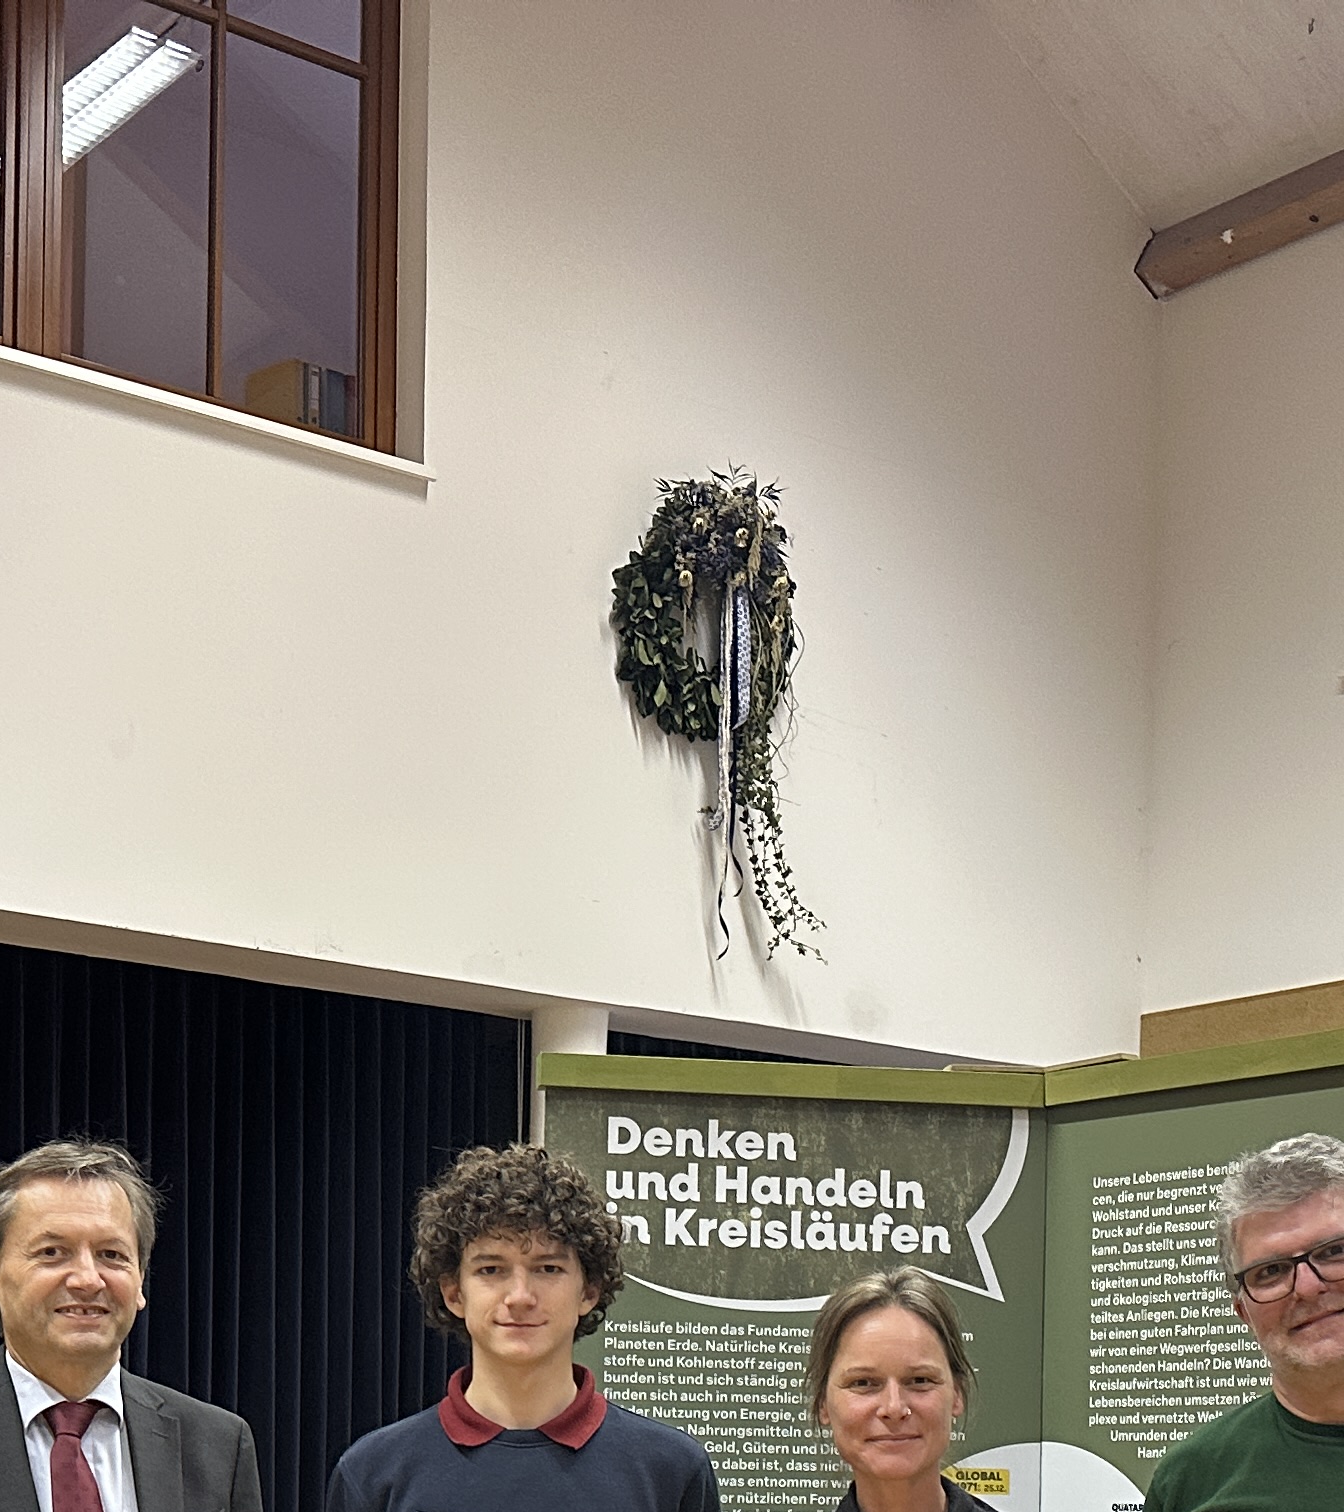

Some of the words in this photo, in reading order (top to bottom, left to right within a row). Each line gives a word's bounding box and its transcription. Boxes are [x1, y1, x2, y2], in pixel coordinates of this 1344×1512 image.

[607, 1115, 796, 1161] Denken
[605, 1162, 700, 1202] und
[715, 1165, 926, 1210] Handeln
[1093, 1175, 1131, 1189] Unsere
[1132, 1167, 1204, 1185] Lebensweise
[1092, 1193, 1115, 1207] cen,
[1117, 1191, 1135, 1204] die
[1136, 1190, 1155, 1203] nur
[1156, 1183, 1208, 1202] begrenzt
[1092, 1204, 1150, 1223] Wohlstand
[1151, 1202, 1172, 1217] und
[1174, 1201, 1207, 1215] unser
[665, 1207, 951, 1255] Kreisläufen
[1092, 1225, 1124, 1239] Druck
[1125, 1223, 1144, 1237] auf
[1145, 1222, 1163, 1235] die
[604, 1320, 674, 1334] Kreisläufe
[675, 1322, 718, 1336] bilden
[720, 1323, 745, 1336] das
[604, 1337, 665, 1351] Planeten
[667, 1338, 703, 1352] Erde.
[705, 1339, 776, 1353] Natürliche
[604, 1355, 645, 1368] stoffe
[647, 1356, 674, 1368] und
[676, 1355, 756, 1370] Kohlenstoff
[758, 1359, 807, 1373] zeigen,
[956, 1471, 1003, 1481] GLOBAL
